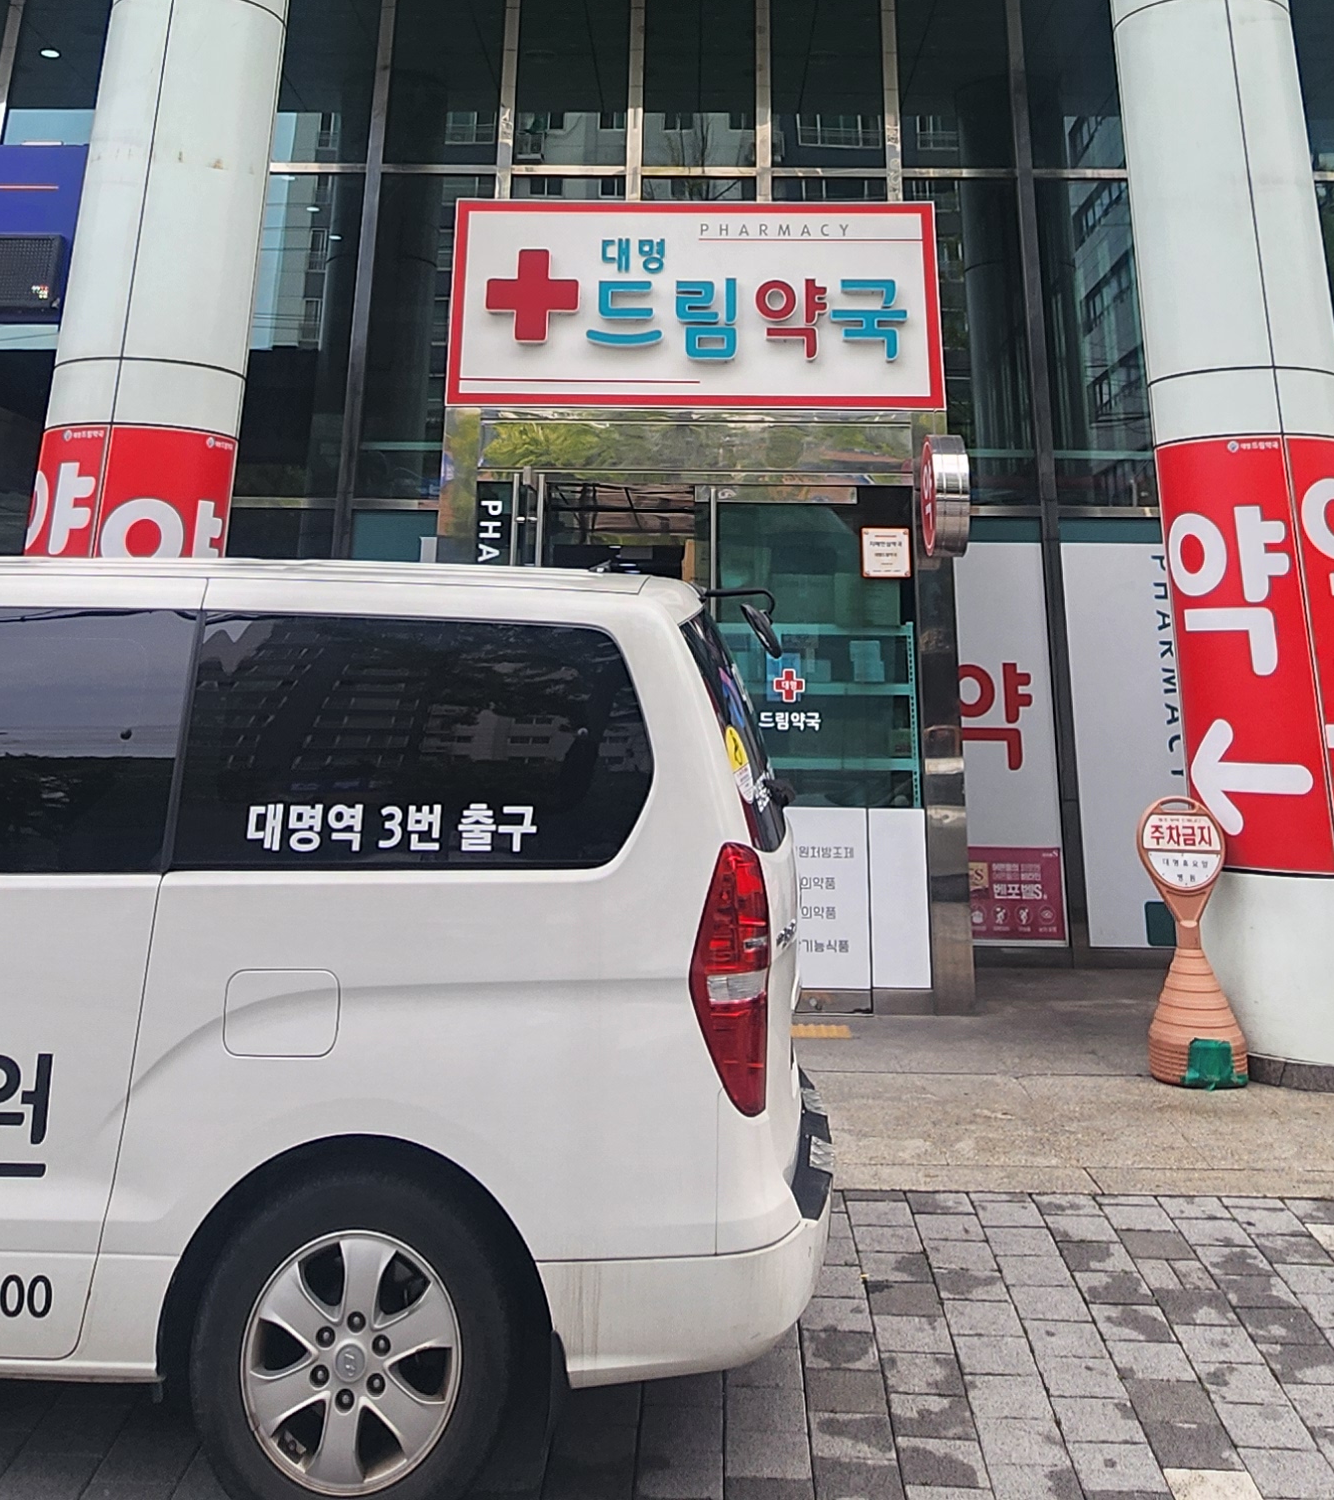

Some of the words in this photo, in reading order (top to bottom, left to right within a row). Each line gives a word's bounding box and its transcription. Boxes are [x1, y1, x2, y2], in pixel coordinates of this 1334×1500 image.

[700, 222, 851, 237] PHARMACY
[601, 237, 667, 275] 대명
[585, 277, 909, 362] 드림약국
[1168, 504, 1291, 677] 약
[758, 712, 822, 731] 드림약국
[959, 662, 1033, 771] 약
[245, 802, 365, 852] 대명역
[377, 802, 442, 851] 3번
[456, 802, 539, 853] 출구
[1150, 824, 1212, 847] 주차금지
[795, 845, 854, 859] 원처방조제
[798, 939, 849, 954] 기능식품
